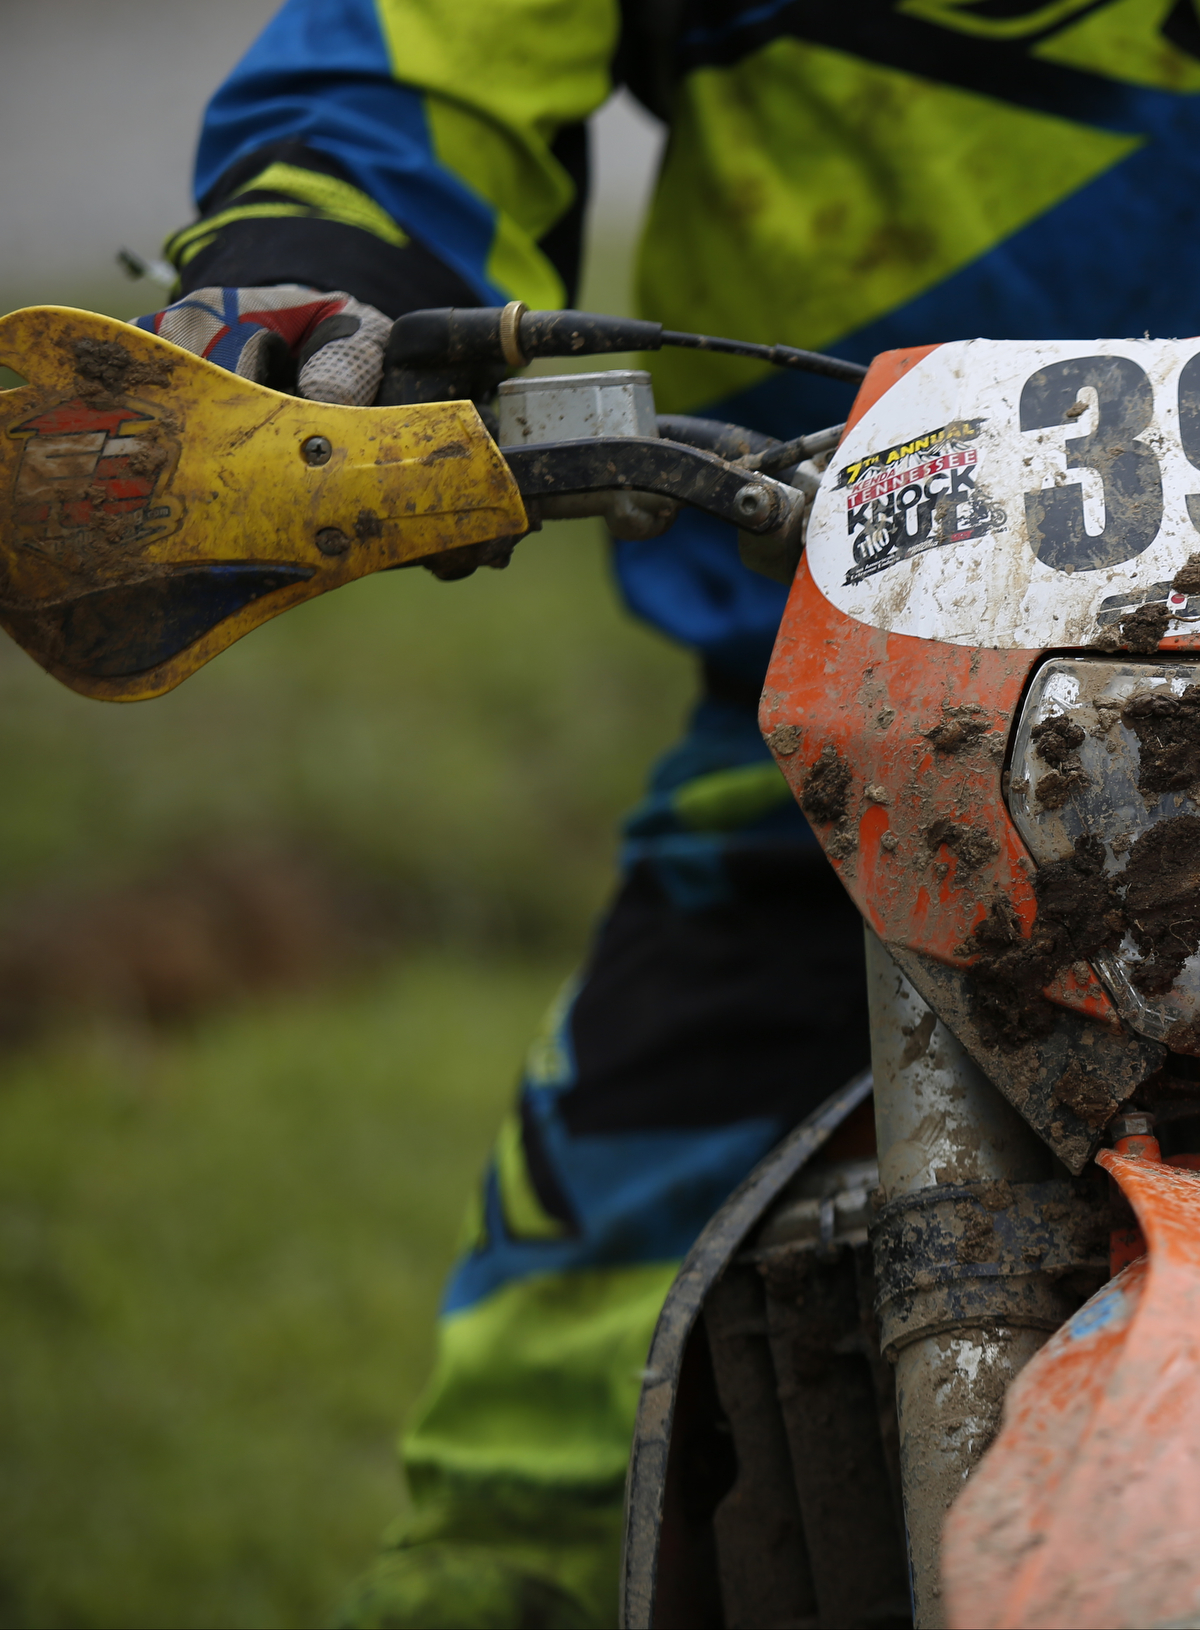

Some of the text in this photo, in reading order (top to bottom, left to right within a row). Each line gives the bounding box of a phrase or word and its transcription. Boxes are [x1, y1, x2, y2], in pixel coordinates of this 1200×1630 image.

[885, 423, 976, 465] ANNUAL
[847, 465, 977, 536] KNOCK
[849, 451, 977, 508] TENNESSEE
[852, 469, 897, 494] KENDA
